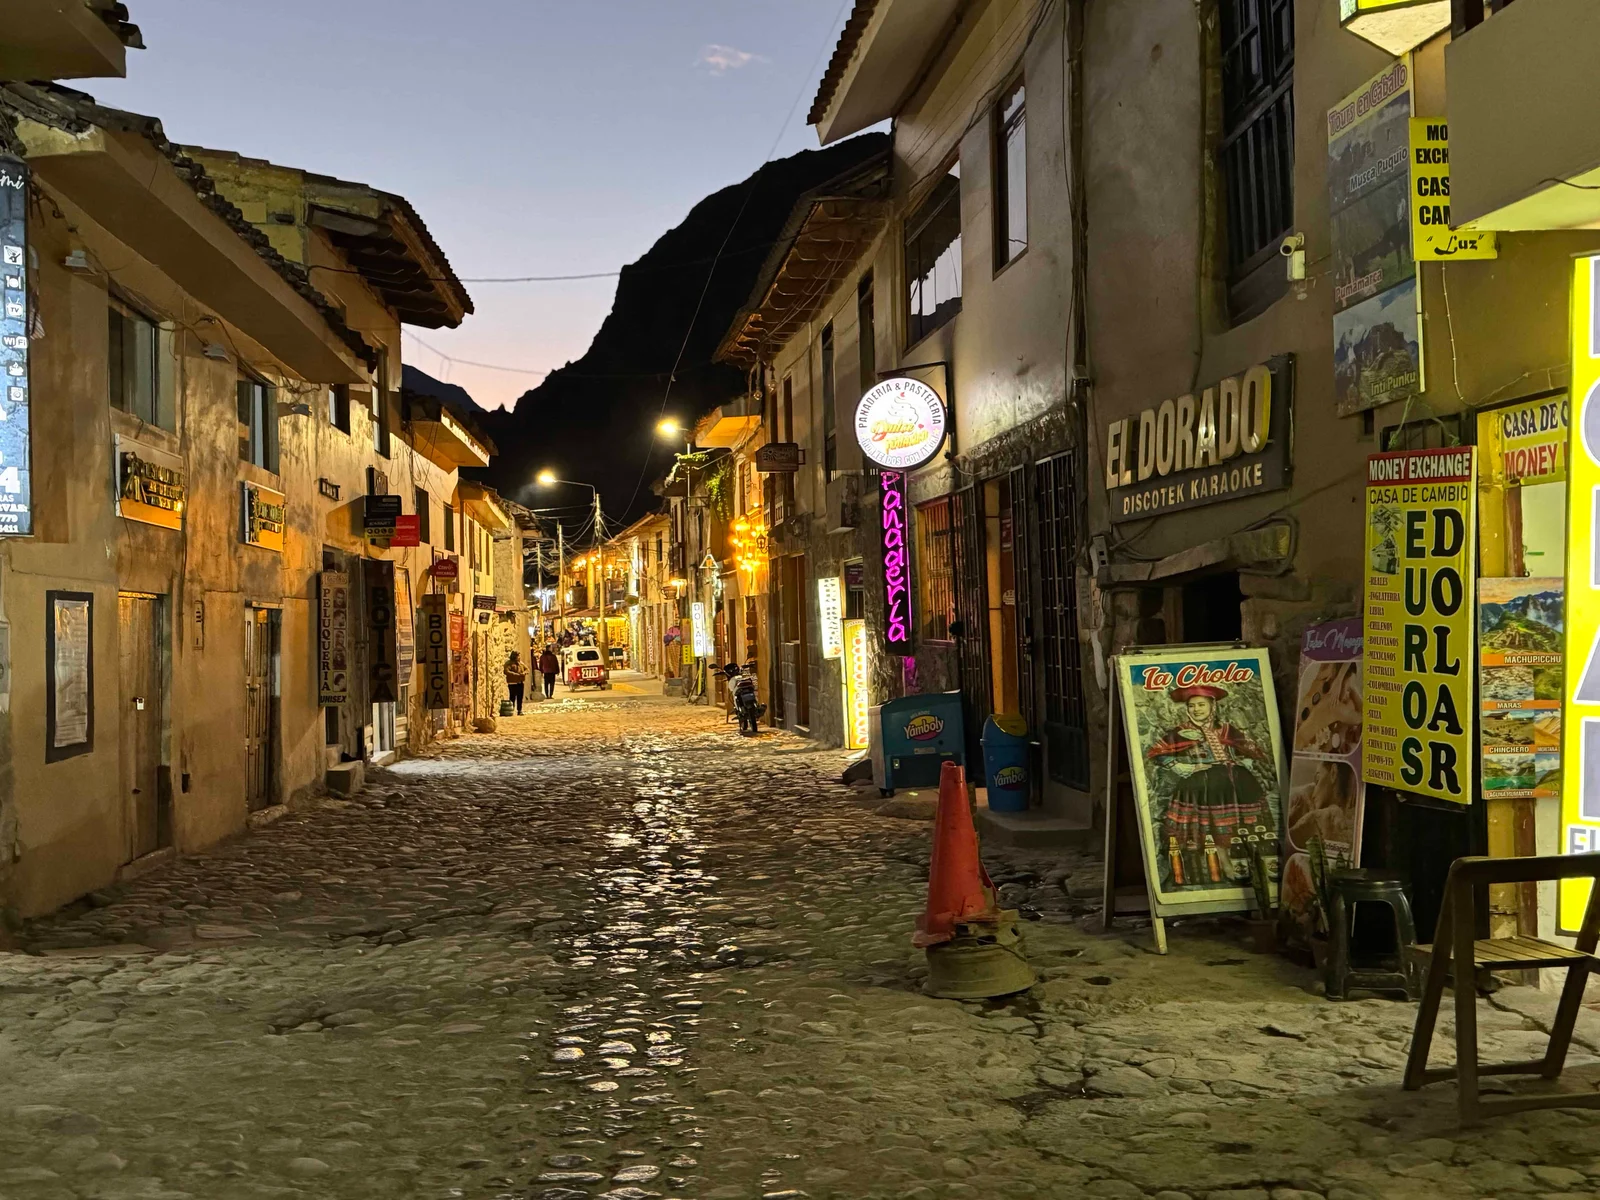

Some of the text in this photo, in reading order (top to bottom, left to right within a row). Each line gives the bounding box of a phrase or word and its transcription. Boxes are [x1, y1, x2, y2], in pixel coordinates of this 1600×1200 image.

[1328, 64, 1407, 136] Tours en Caballo
[1377, 147, 1408, 175] Puquio
[1370, 371, 1417, 397] Inti Punku
[858, 381, 942, 429] PANADERIA & PASTELERIA
[1503, 407, 1538, 438] CASA
[1540, 402, 1558, 431] DE
[1106, 364, 1272, 490] EL DORADO
[1369, 452, 1470, 481] MONEY EXCHANGE
[1504, 443, 1558, 480] MONEY
[1123, 463, 1263, 514] DISCOTEK KARAOKE
[1370, 485, 1468, 504] CASA DE CAMBIO
[321, 588, 331, 691] PELUQUERIA
[371, 587, 393, 702] BOTICA
[428, 614, 445, 706] BOTICA
[1142, 662, 1253, 691] La Chola
[1504, 654, 1562, 664] MACHUPICCHU
[320, 695, 347, 703] UNISEX
